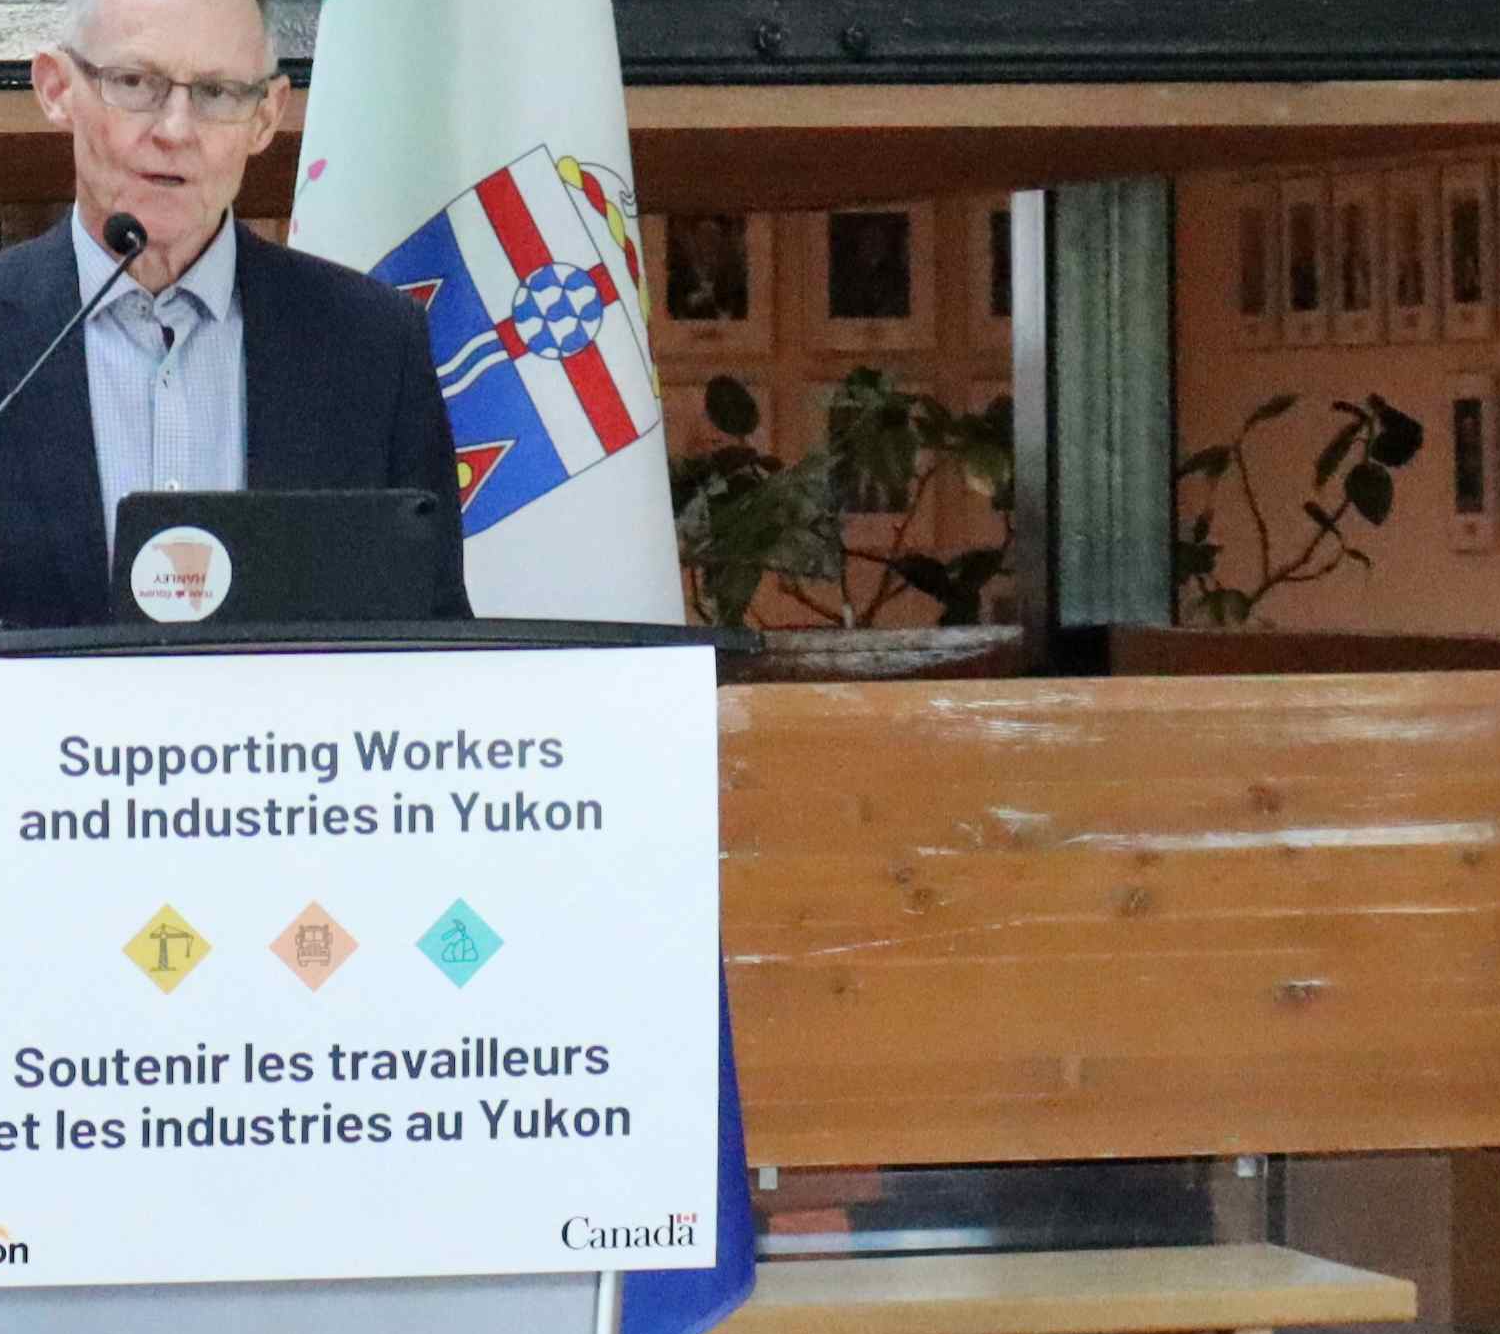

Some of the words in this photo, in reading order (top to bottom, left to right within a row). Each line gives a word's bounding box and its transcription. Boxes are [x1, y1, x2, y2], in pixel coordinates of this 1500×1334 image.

[60, 732, 338, 785] Supporting
[354, 730, 564, 771] Workers
[19, 798, 110, 840] and
[127, 794, 378, 838] Industries
[394, 793, 434, 834] in
[450, 791, 602, 832] Yukon
[14, 1043, 230, 1088] Soutenir
[244, 1042, 314, 1083] les
[328, 1036, 610, 1081] travailleurs
[56, 1109, 126, 1149] les
[141, 1104, 392, 1148] industries
[406, 1110, 463, 1142] au
[479, 1098, 631, 1140] Yukon
[561, 1213, 697, 1250] Canada
